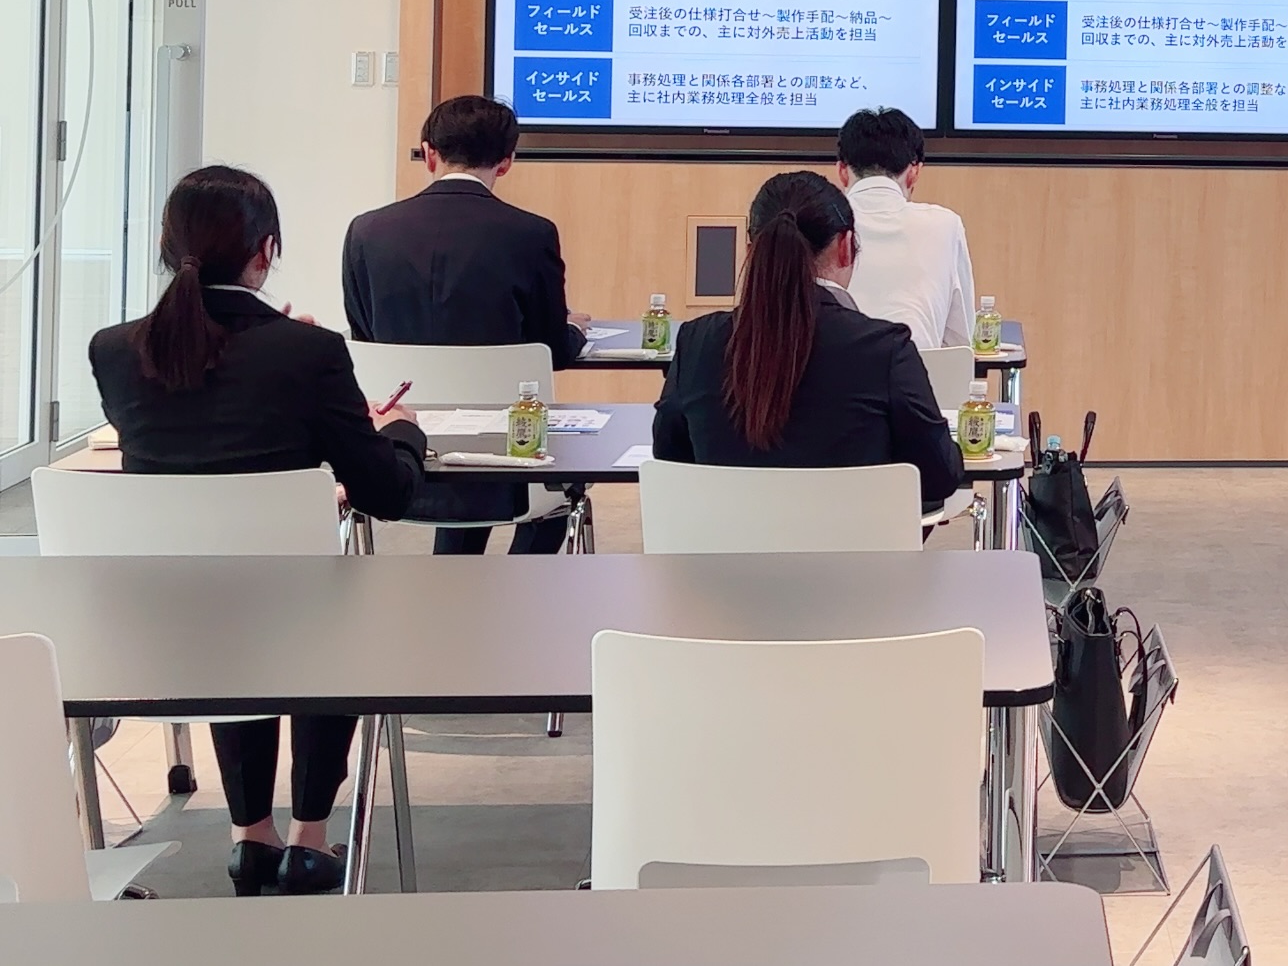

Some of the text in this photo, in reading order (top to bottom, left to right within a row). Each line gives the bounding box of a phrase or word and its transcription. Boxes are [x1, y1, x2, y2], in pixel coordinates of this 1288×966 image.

[168, 0, 197, 8] PULL
[528, 5, 601, 19] フィールド
[987, 14, 1055, 28] フィールド
[534, 22, 593, 35] セールス
[993, 31, 1048, 43] セールス
[526, 71, 599, 86] インサイド
[986, 78, 1054, 92] インサイド
[532, 89, 591, 102] セールス
[627, 89, 817, 106] 主に社内業務処理全般を担当
[991, 95, 1047, 108] セールス
[1080, 96, 1258, 113] 主に社内業務処理全般を担当
